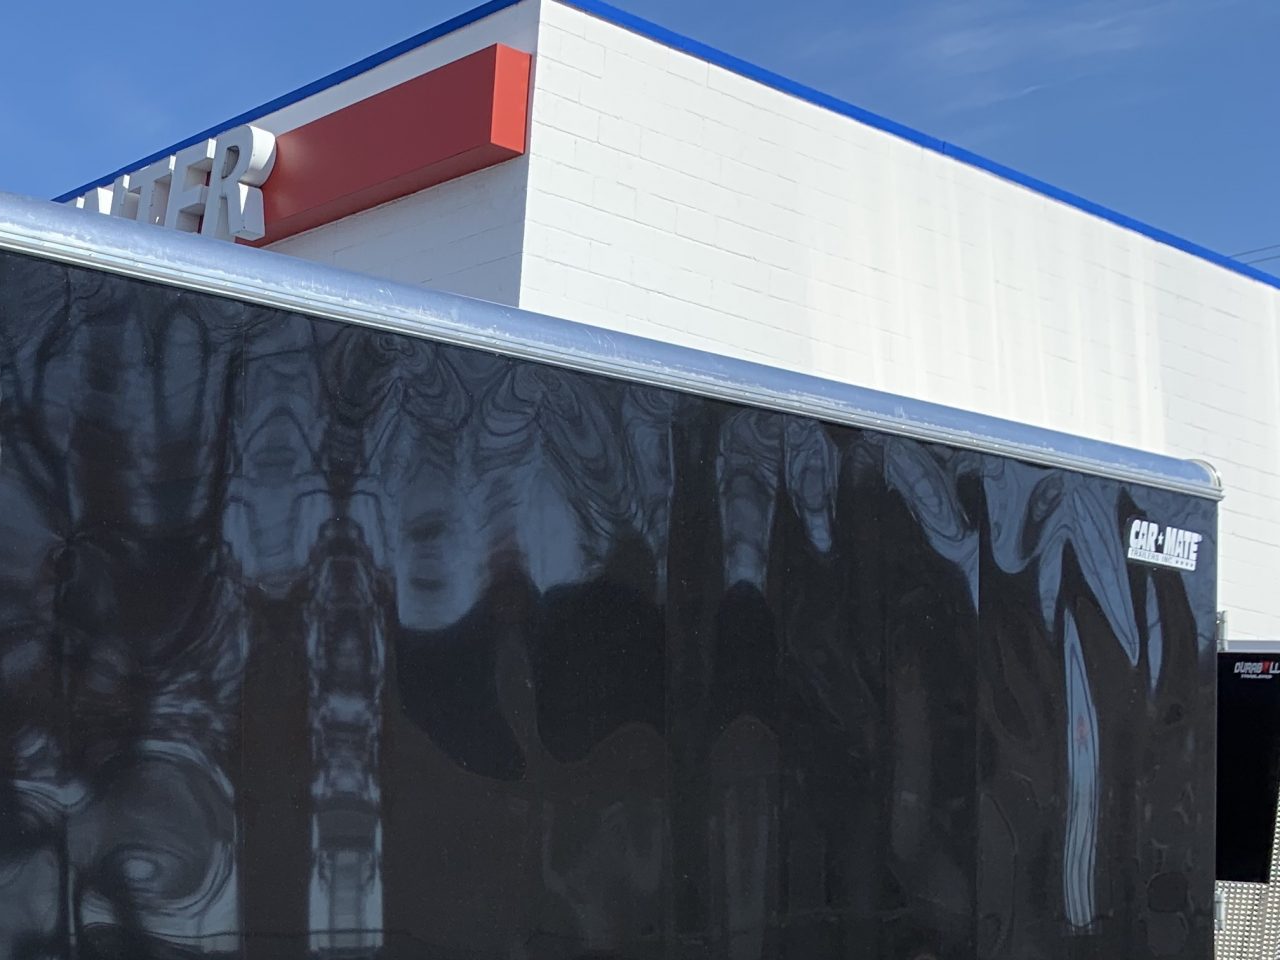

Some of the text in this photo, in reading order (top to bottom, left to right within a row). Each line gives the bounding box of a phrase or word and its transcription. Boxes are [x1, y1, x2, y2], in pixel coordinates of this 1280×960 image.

[1129, 519, 1201, 561] CAR MATE
[1130, 549, 1160, 561] TRAILERS
